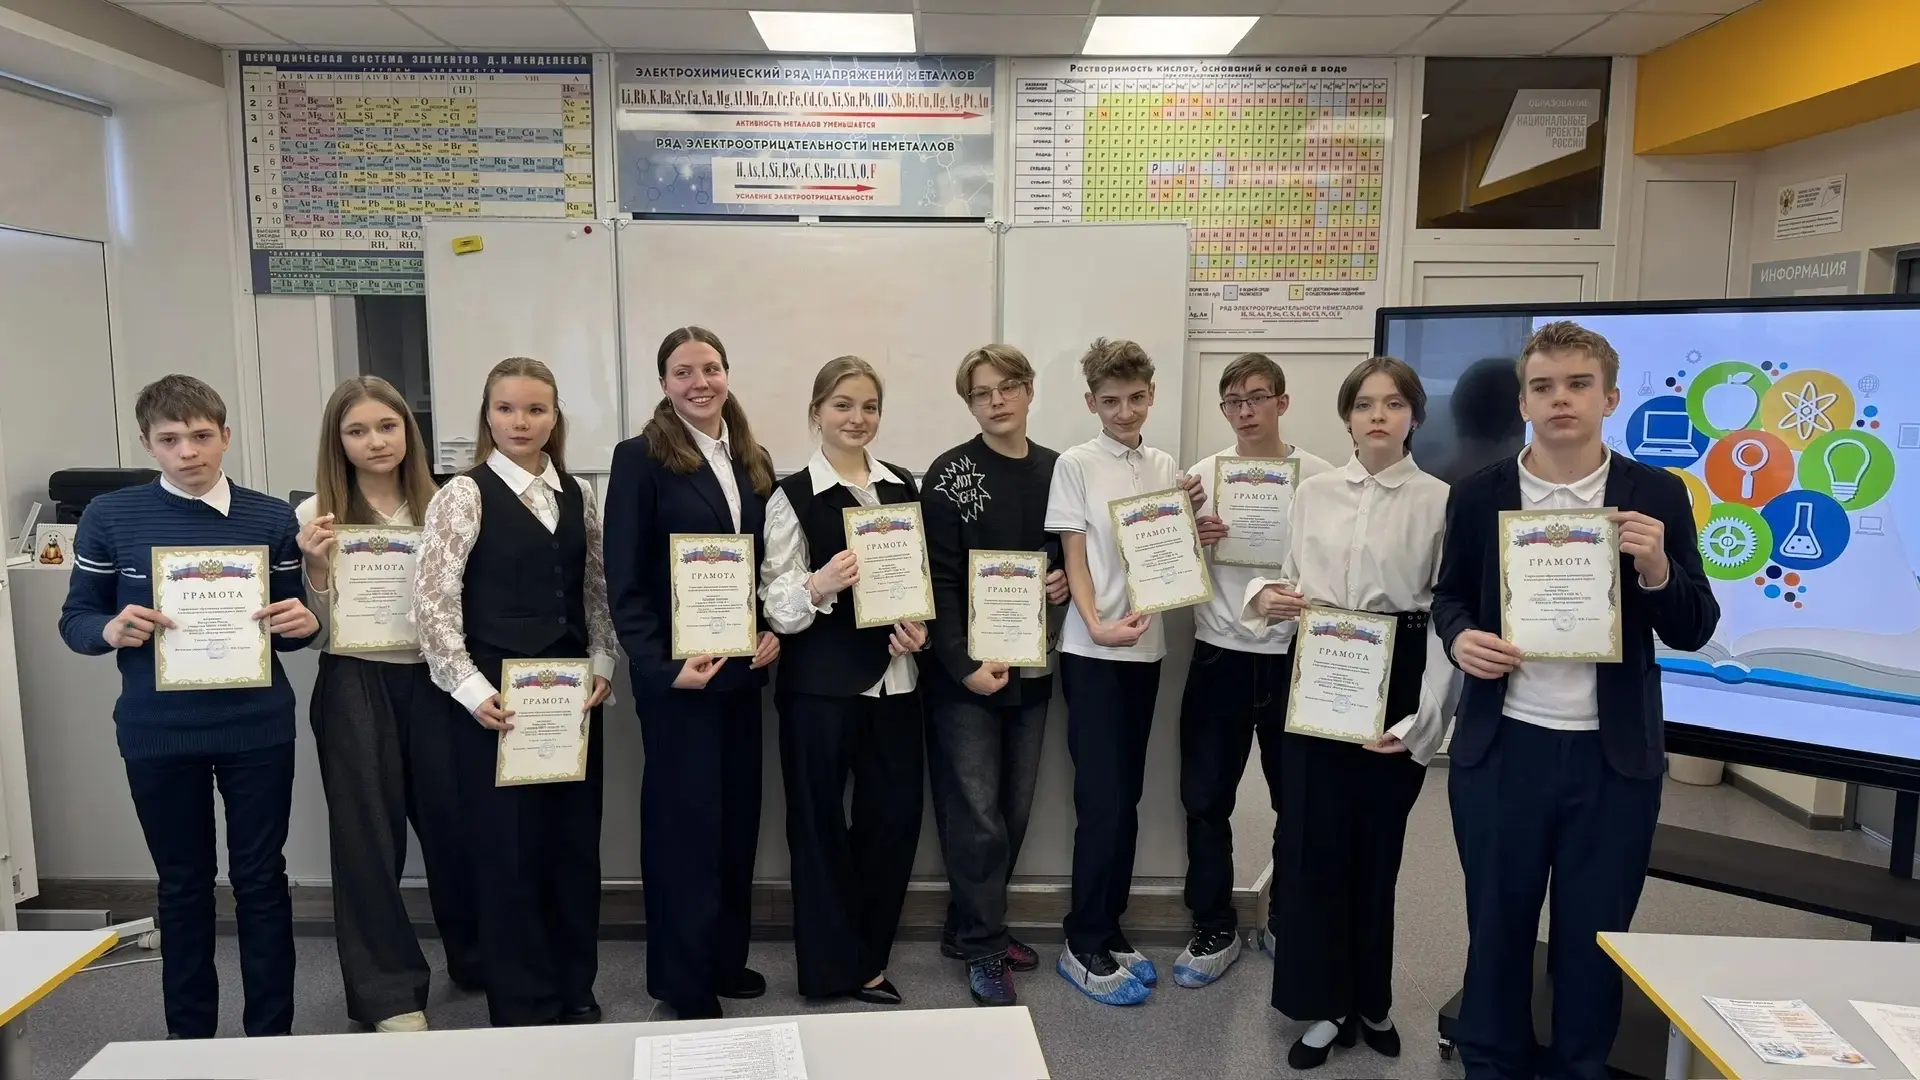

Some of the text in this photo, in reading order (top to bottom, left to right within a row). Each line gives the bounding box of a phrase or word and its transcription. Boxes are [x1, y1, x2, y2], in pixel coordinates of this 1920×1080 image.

[246, 54, 342, 63] ПЕРИОДИЧЕСКАЯ
[635, 66, 975, 81] ЭЛЕКТРОХИМИЧЕСКИЙ РЯД НАПРЯЖЕНИЙ МЕТАЛЛОВ
[1070, 64, 1152, 73] Растворимость
[1516, 116, 1585, 126] НАЦИОНАЛЬНЫЕ
[1546, 127, 1584, 137] ПРОЕКТЫ
[656, 138, 955, 151] РЯД ЭЛЕКТРООТРИЦАТЕЛЬНОСТИ НЕМЕТАЛЛОВ
[1552, 138, 1584, 148] РОССИИ
[1761, 261, 1846, 282] ИНФОРМАЦИЯ
[1234, 492, 1278, 501] ГРАМОТА
[1136, 526, 1178, 540] ГРАМОТА
[866, 541, 908, 550] ГРАМОТА
[1529, 557, 1591, 566] ГРАМОТА
[183, 591, 244, 600] ГРАМОТА
[1318, 647, 1369, 661] ГРАМОТА
